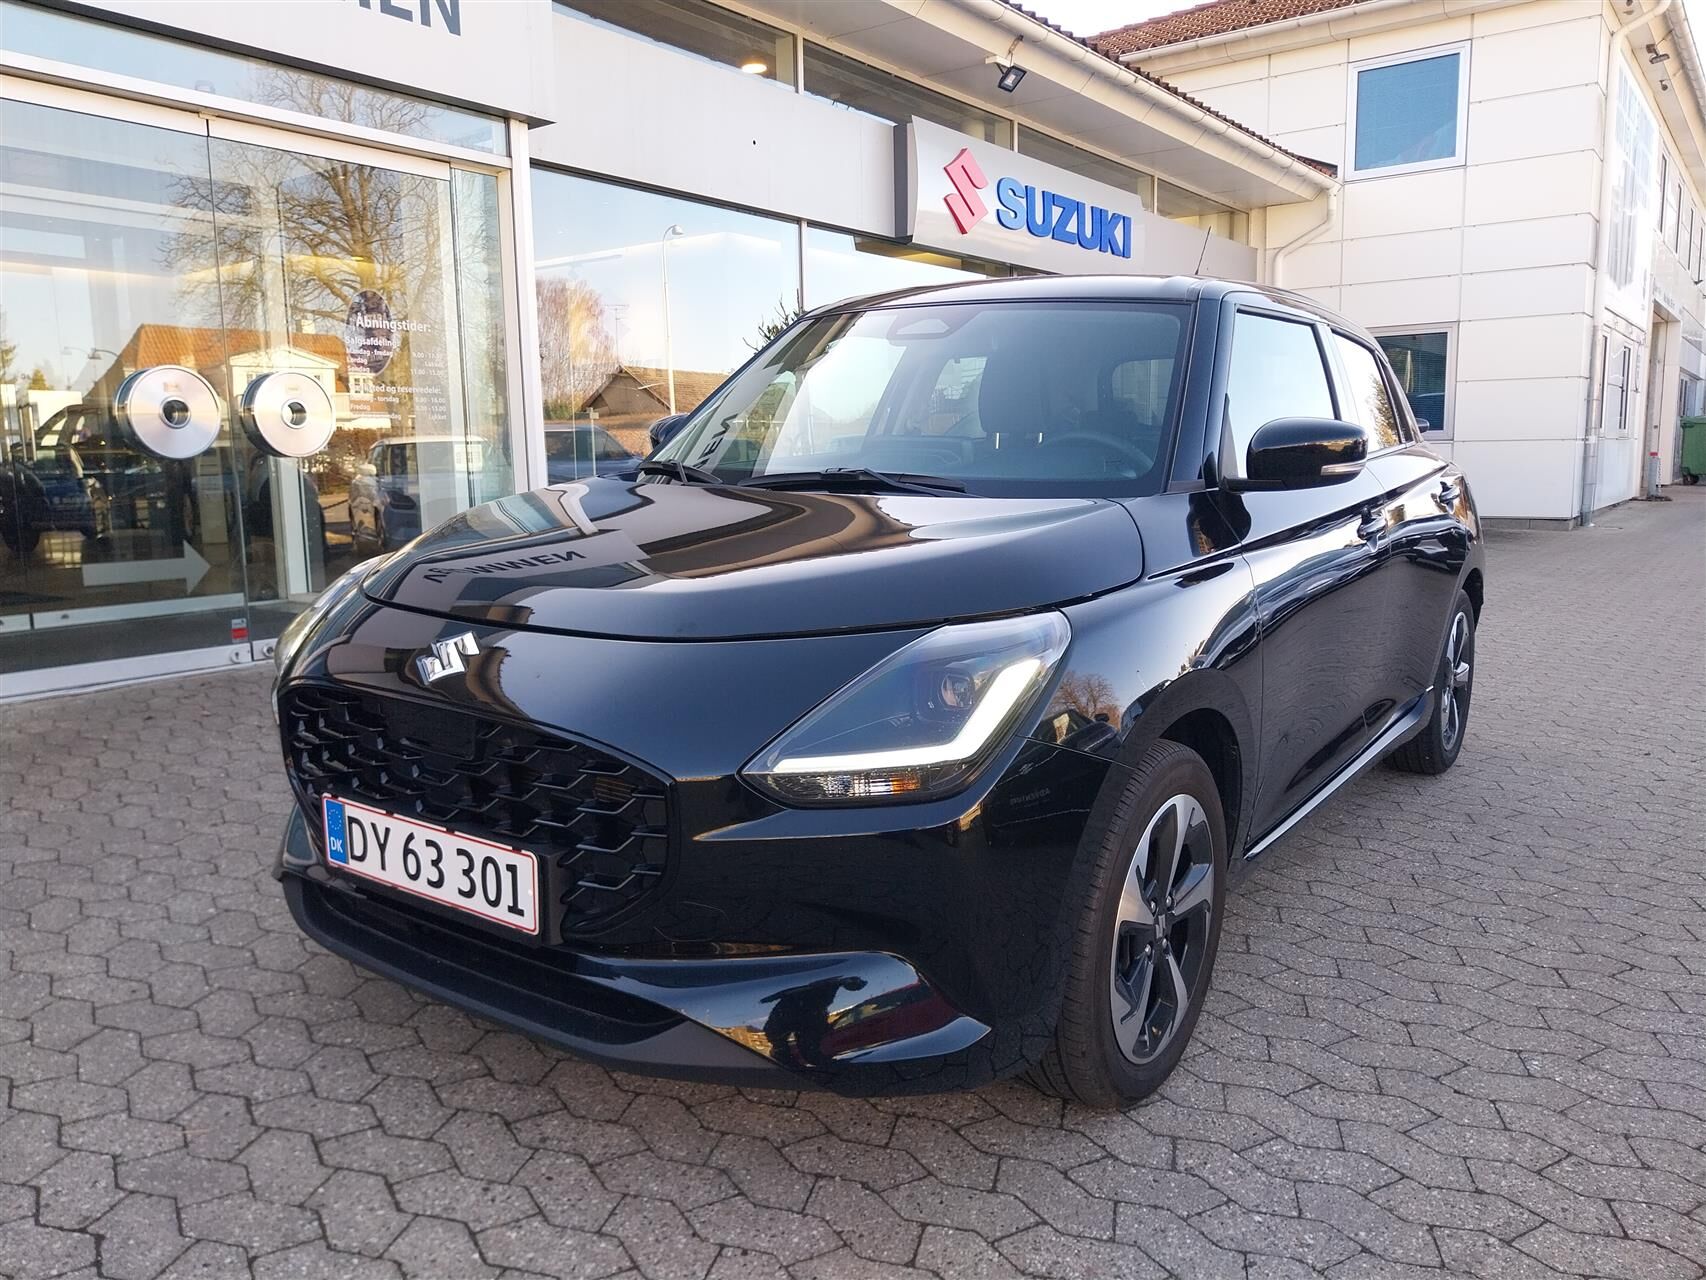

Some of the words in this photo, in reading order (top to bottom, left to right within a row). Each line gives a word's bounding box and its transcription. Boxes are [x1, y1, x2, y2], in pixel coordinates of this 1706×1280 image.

[996, 177, 1132, 259] SUZUKI
[356, 312, 431, 332] Åbningstider:
[330, 836, 343, 853] DK
[347, 815, 391, 871] DY
[402, 832, 445, 889] 63
[456, 848, 525, 917] 301
